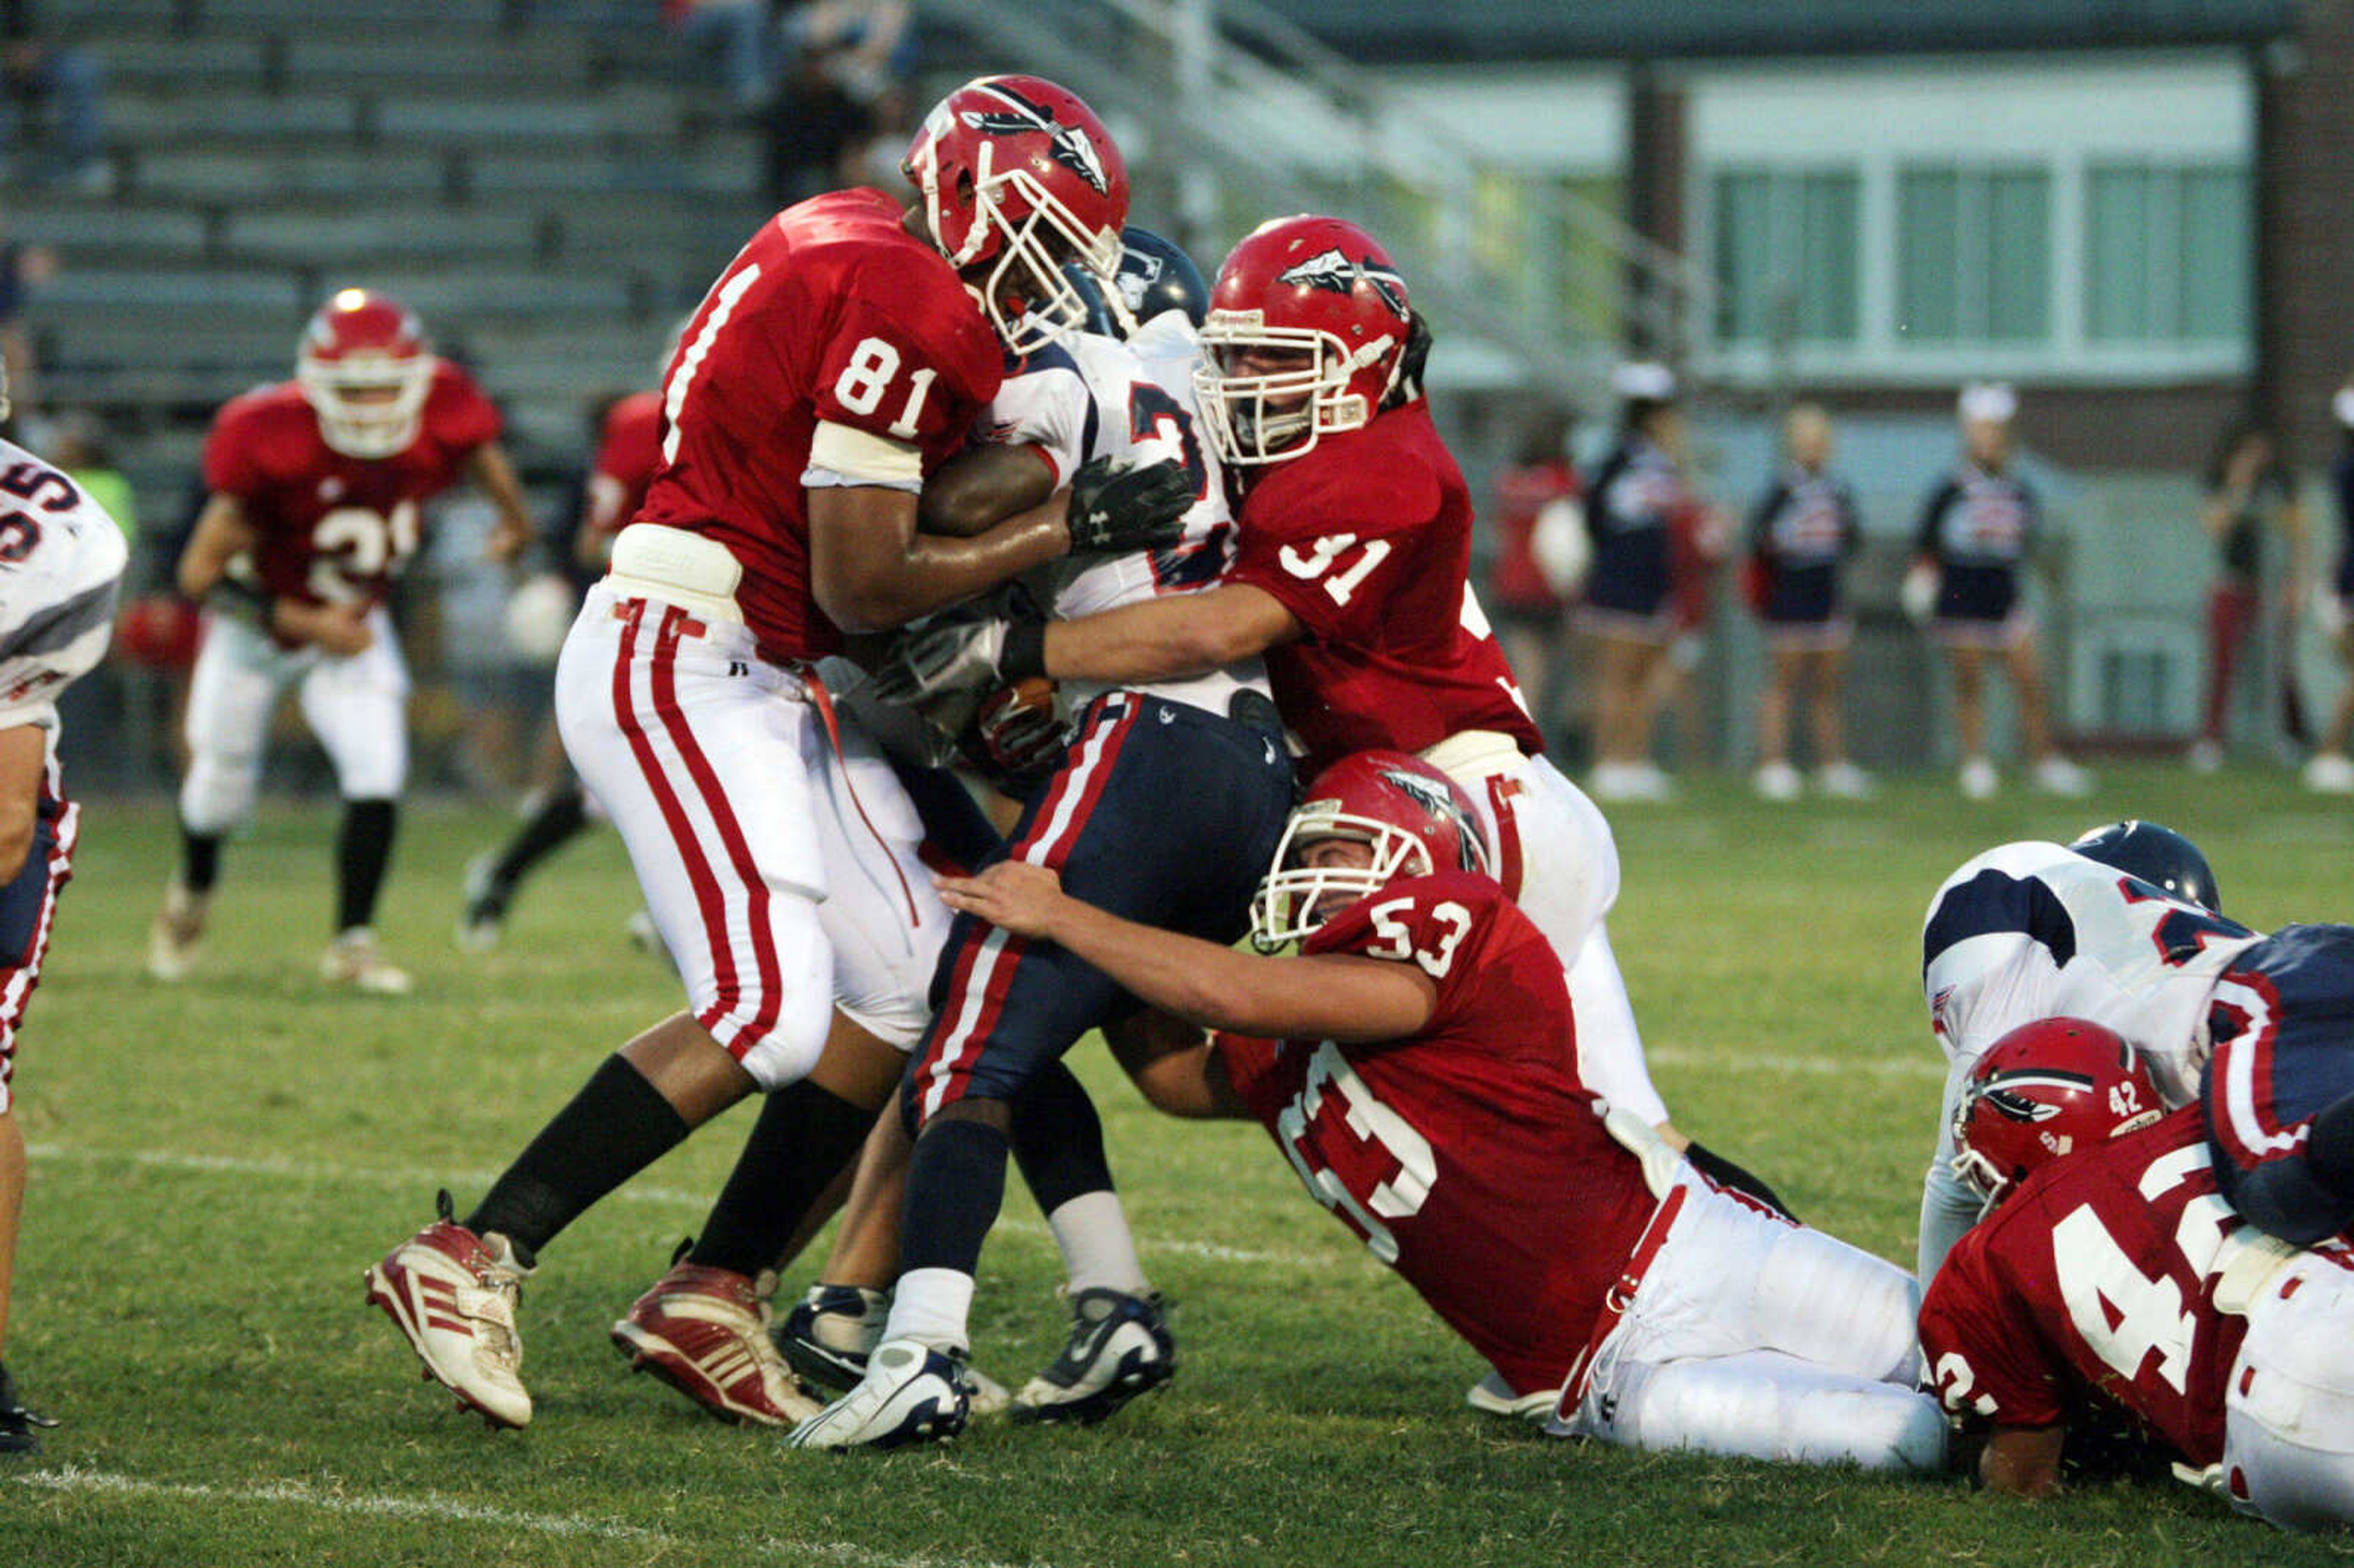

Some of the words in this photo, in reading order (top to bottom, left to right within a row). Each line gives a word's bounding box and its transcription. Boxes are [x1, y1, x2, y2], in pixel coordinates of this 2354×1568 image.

[834, 337, 937, 439] 81
[1367, 897, 1472, 979] 53
[2109, 1081, 2143, 1117] 42
